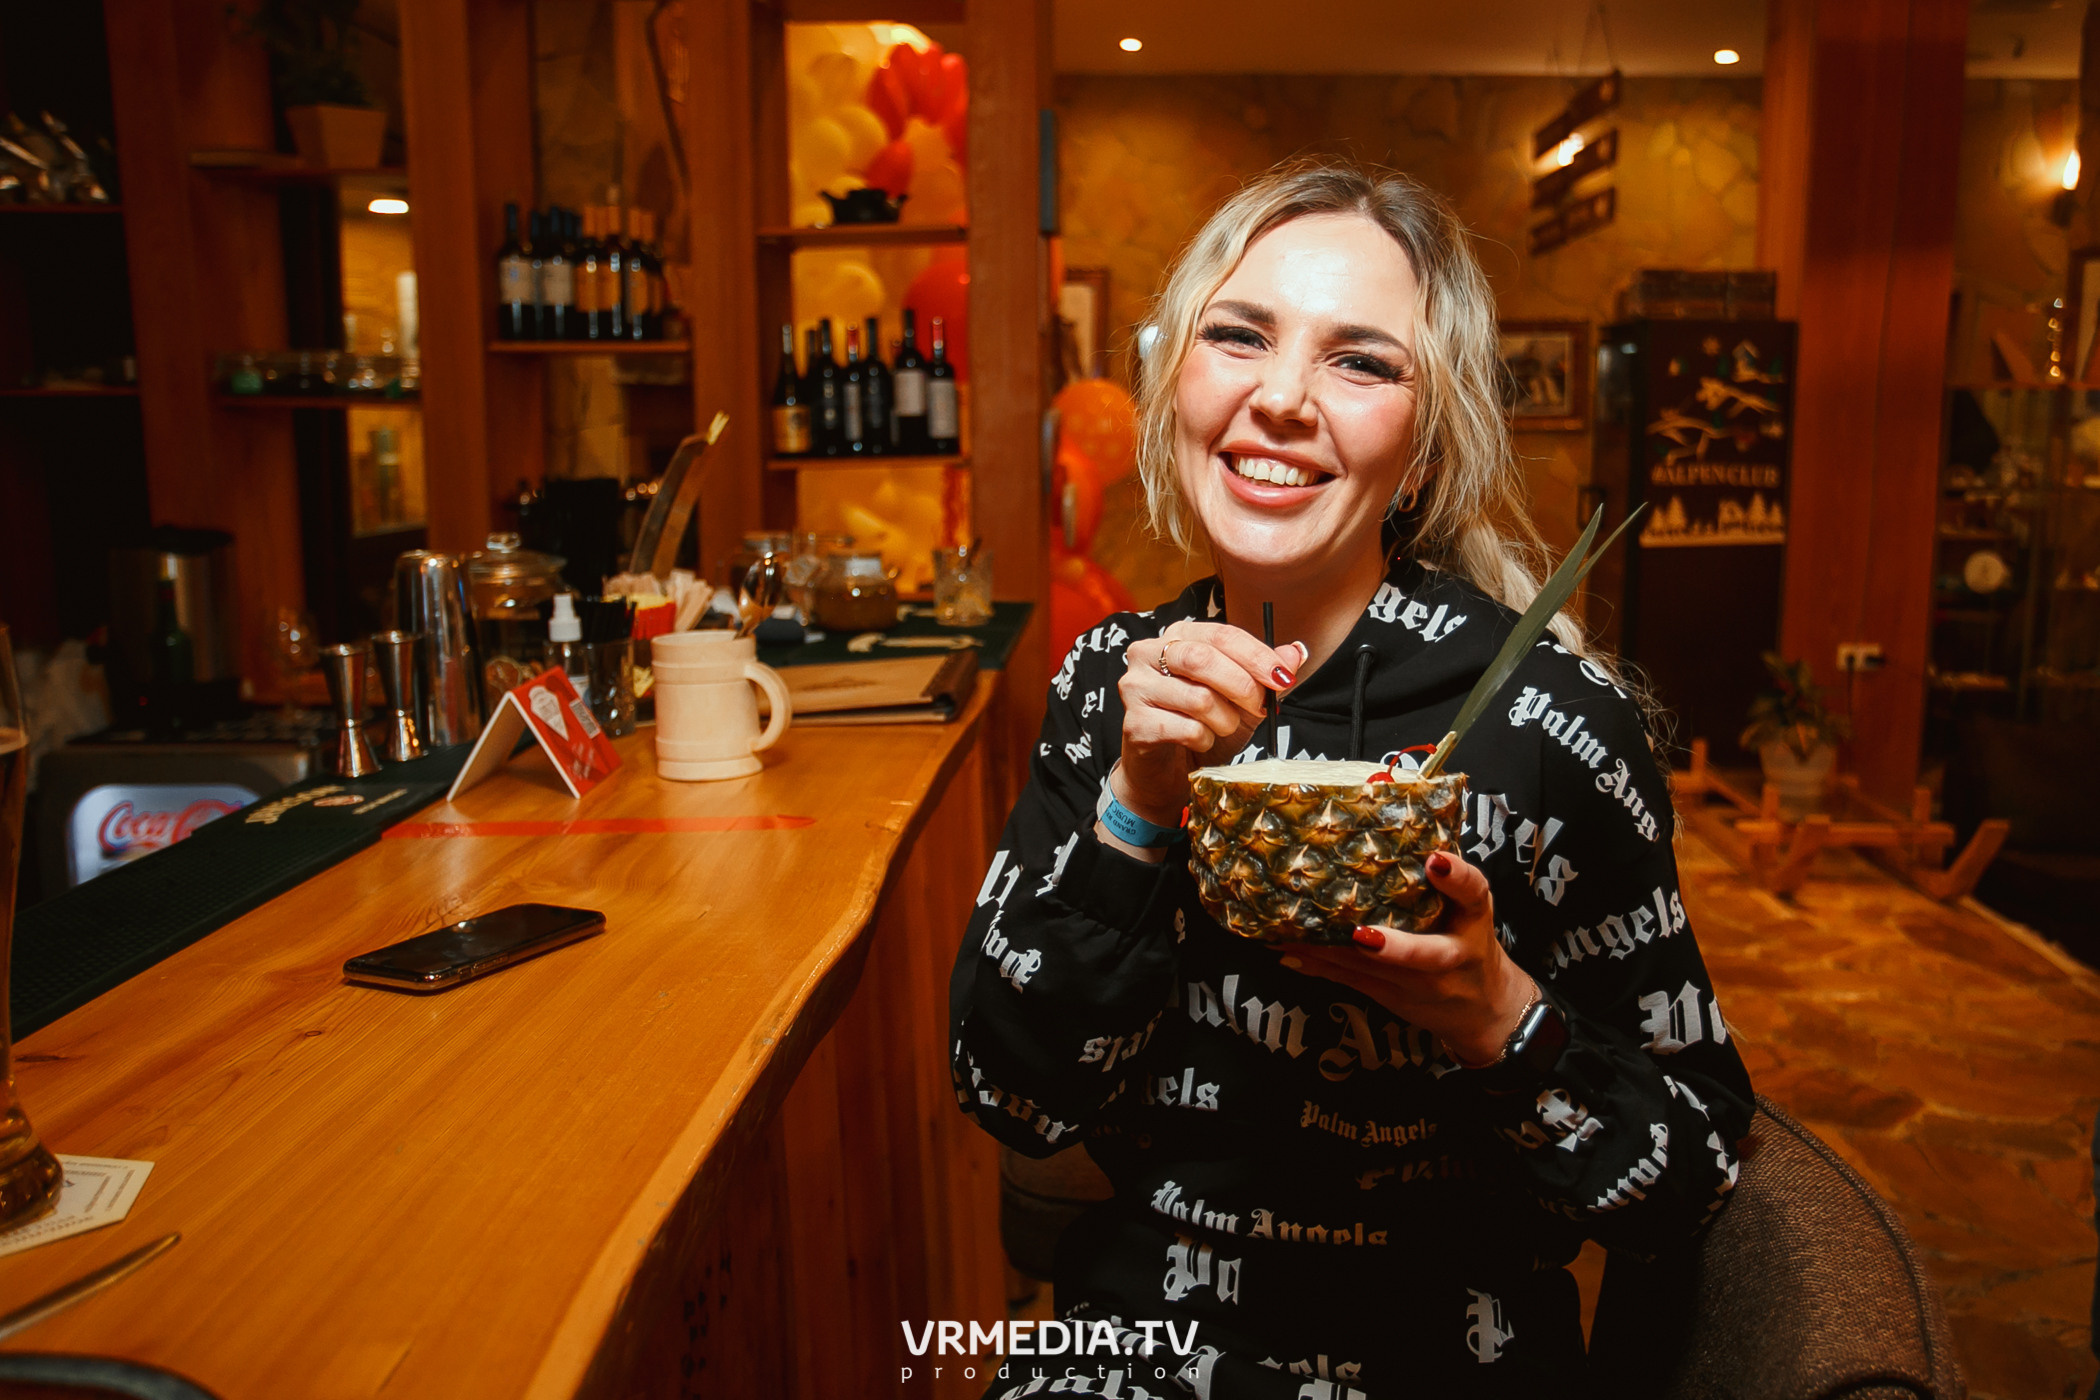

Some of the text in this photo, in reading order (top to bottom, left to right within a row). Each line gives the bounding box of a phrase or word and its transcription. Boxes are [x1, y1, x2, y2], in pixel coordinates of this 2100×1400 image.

[1508, 685, 1609, 769] Palm
[1111, 805, 1136, 828] MUSIC
[1112, 818, 1137, 836] GRAND
[1300, 1099, 1438, 1149] Palm Angels
[1149, 1179, 1241, 1236] Palm
